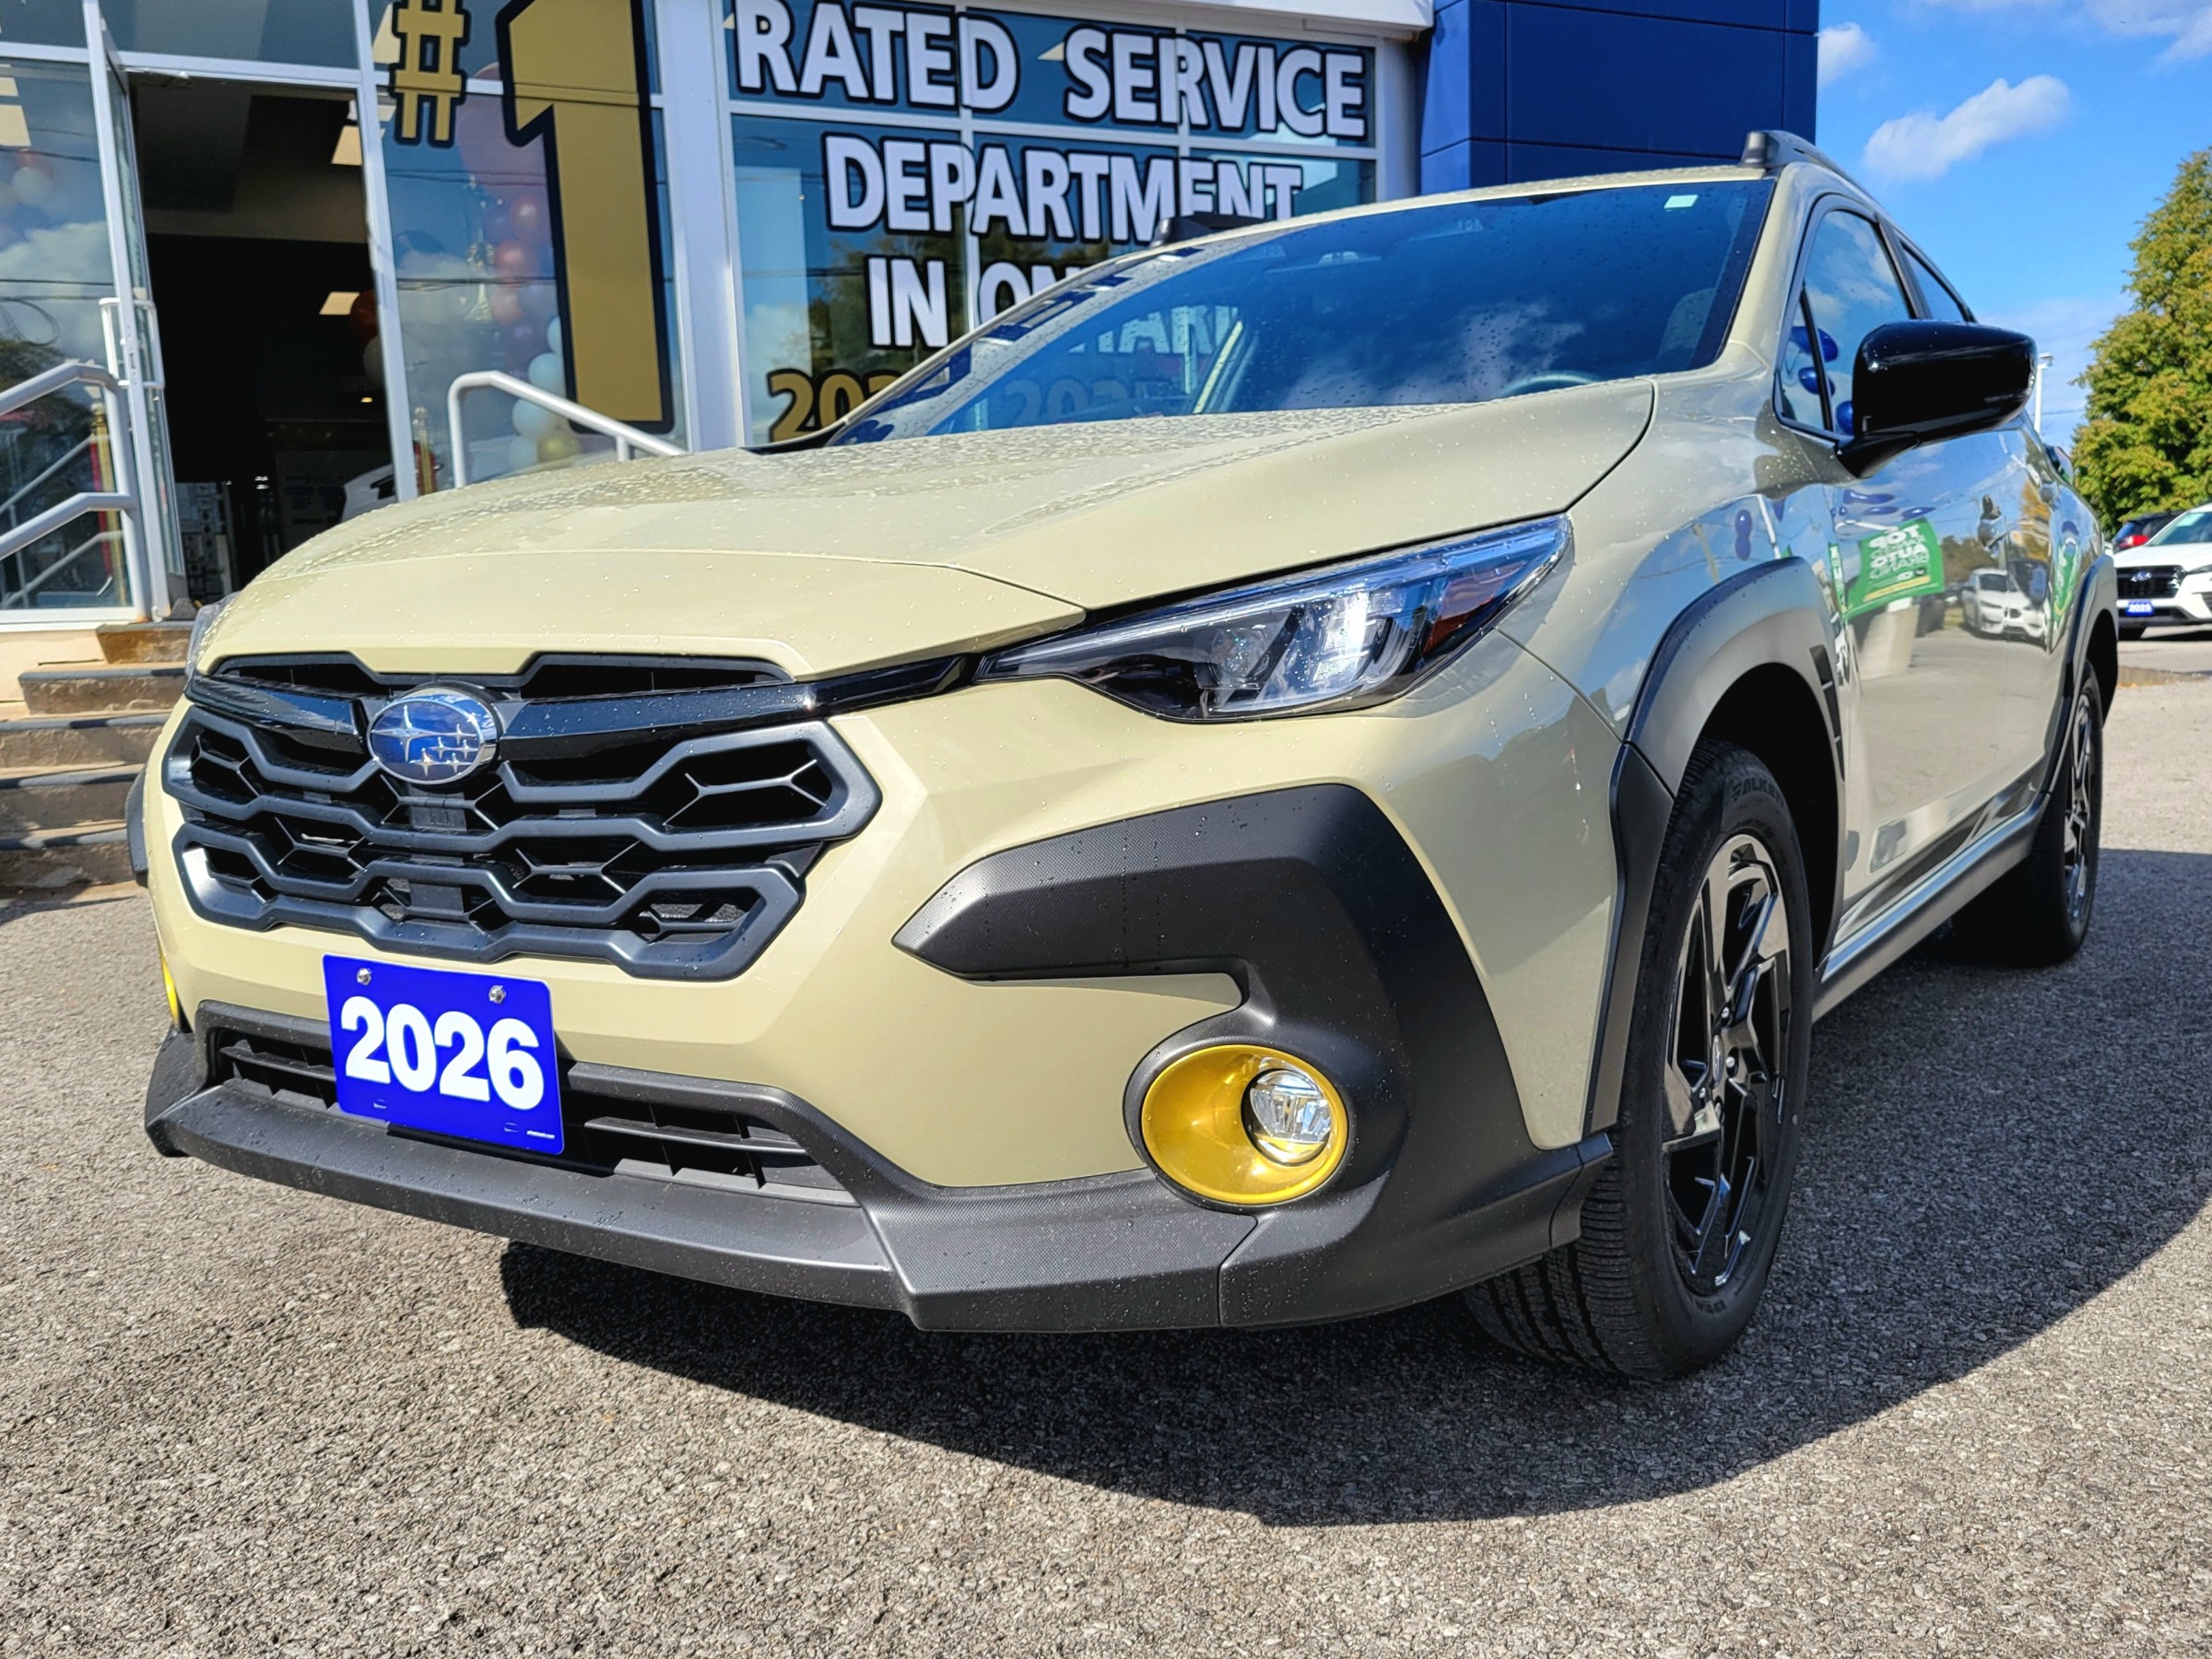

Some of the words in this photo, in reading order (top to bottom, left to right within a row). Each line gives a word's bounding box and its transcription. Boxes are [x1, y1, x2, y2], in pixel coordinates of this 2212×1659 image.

[736, 0, 1018, 111] RATED
[1065, 27, 1365, 137] SERVICE
[830, 137, 1301, 241] DEPARTMENT
[868, 258, 949, 347] IN
[340, 995, 545, 1111] 2026
